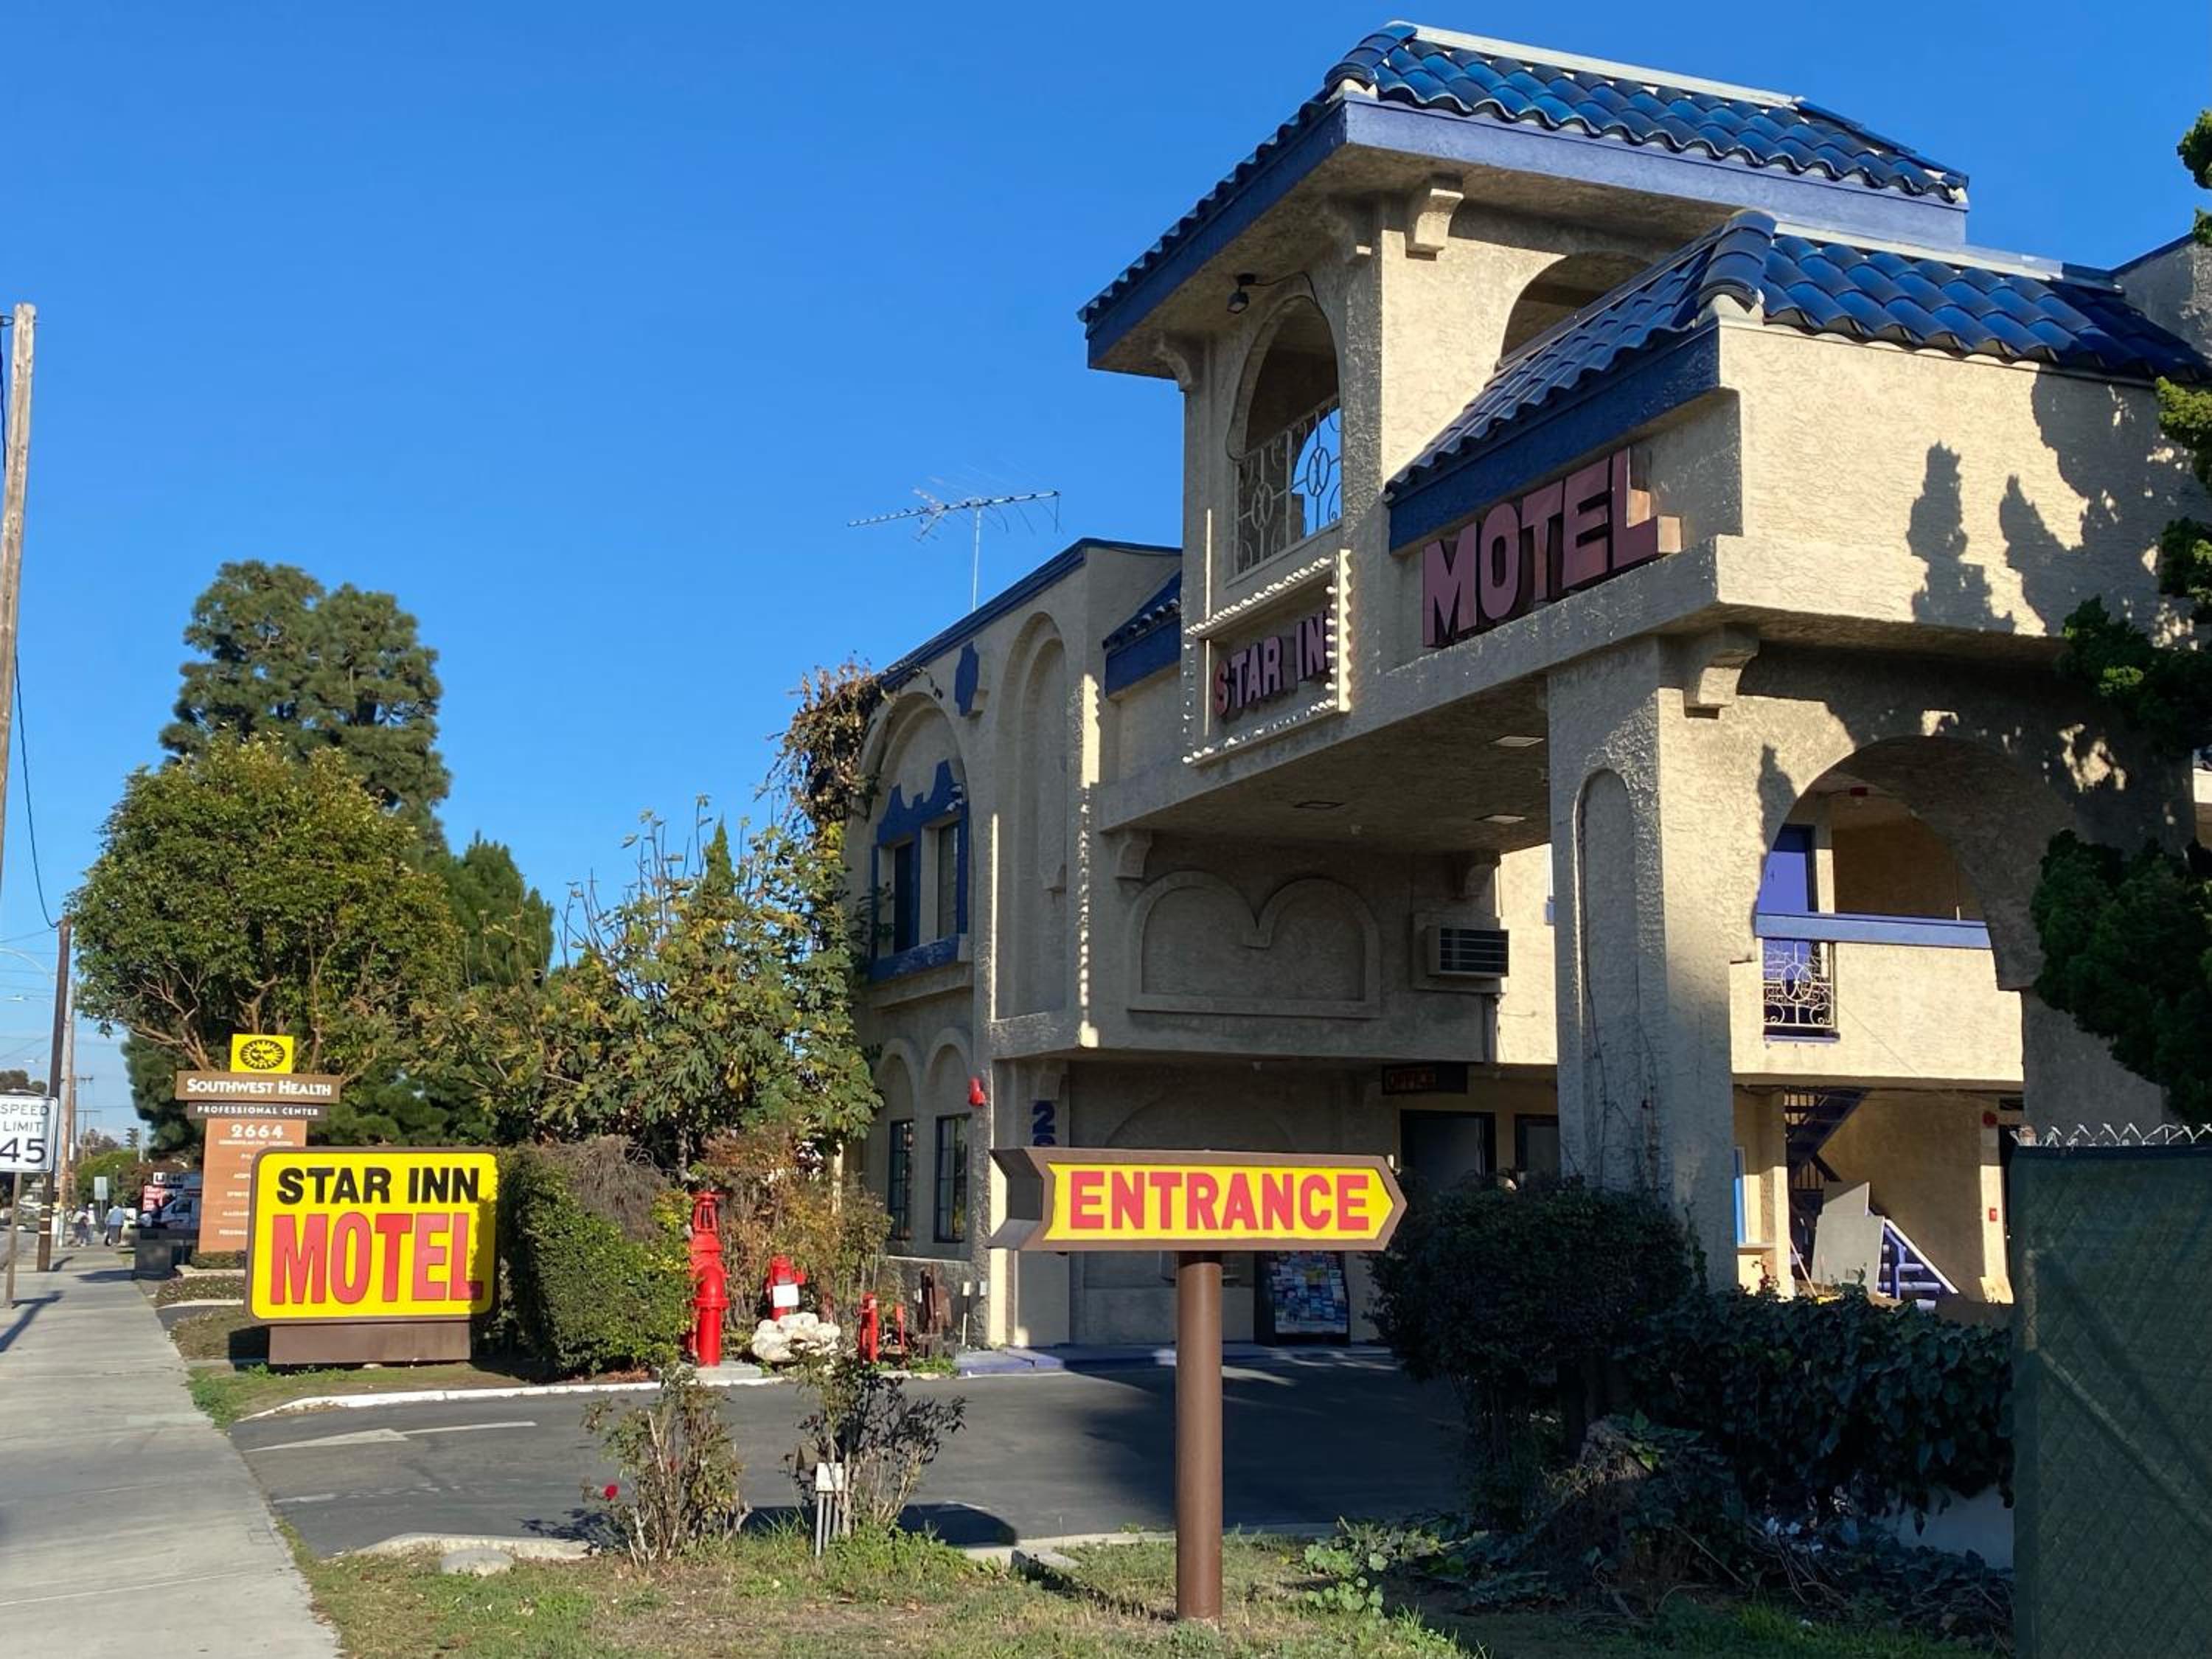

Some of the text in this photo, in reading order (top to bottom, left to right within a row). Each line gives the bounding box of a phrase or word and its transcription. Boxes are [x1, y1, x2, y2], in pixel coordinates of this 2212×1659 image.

[1422, 446, 1659, 649] MOTEL
[1214, 636, 1281, 718] STAR
[0, 1104, 49, 1116] SPEED
[197, 1105, 318, 1116] PROFESSIONAL CENTER
[4, 1121, 41, 1132] LIMIT
[231, 1124, 284, 1138] 2664
[0, 1137, 46, 1164] 45
[276, 1167, 480, 1204] STAR INN
[1070, 1171, 1369, 1231] ENTRANCE
[270, 1211, 484, 1305] MOTEL
